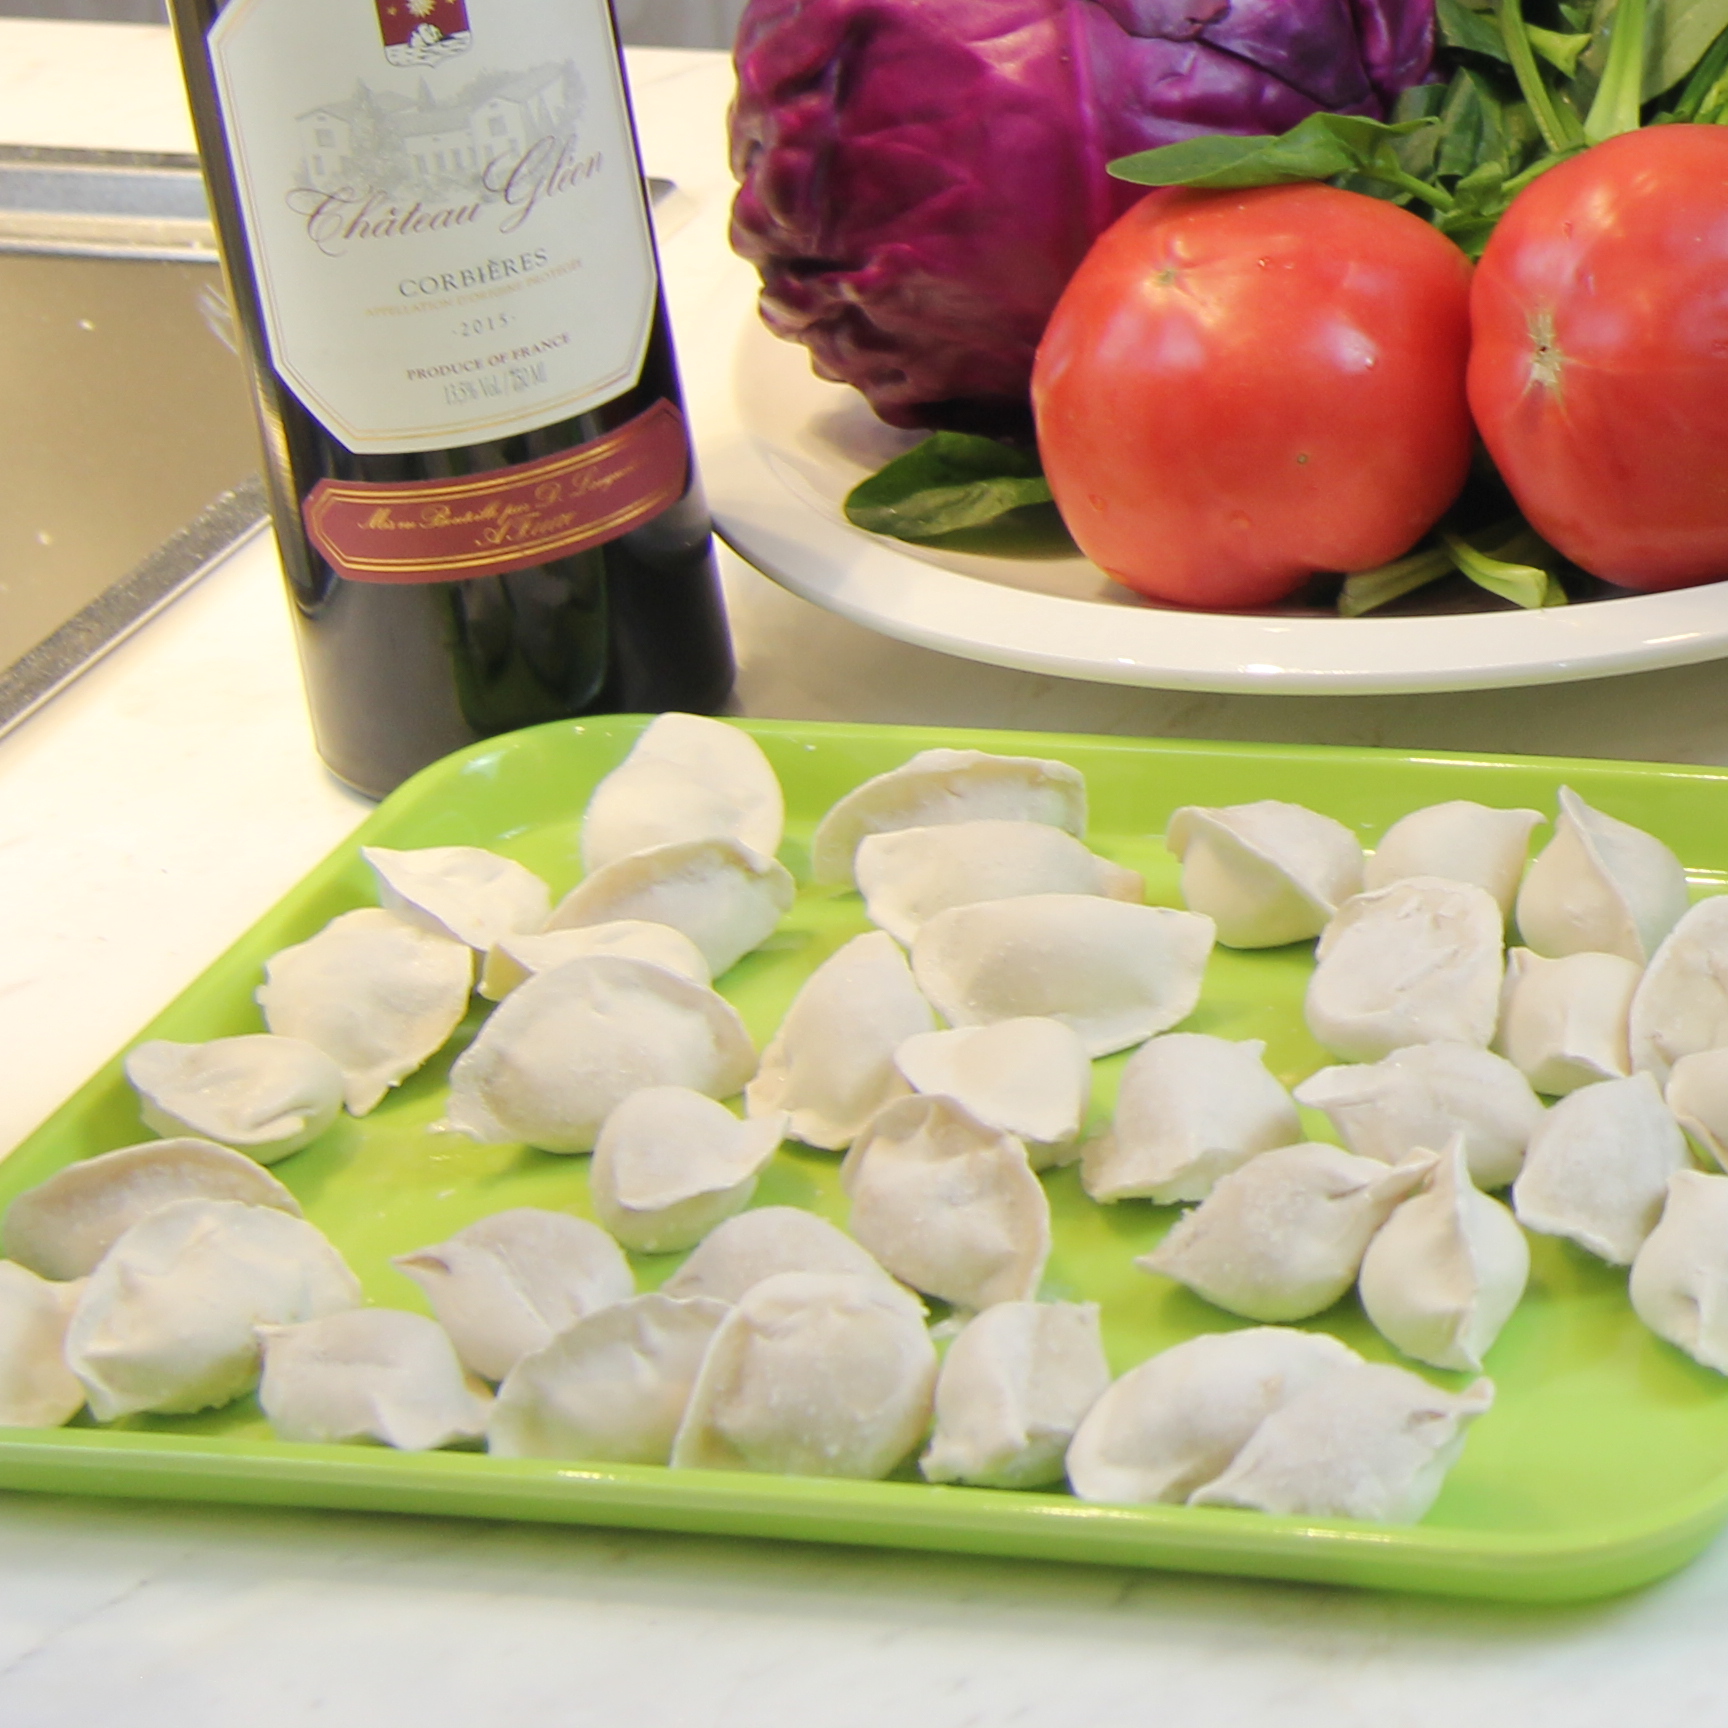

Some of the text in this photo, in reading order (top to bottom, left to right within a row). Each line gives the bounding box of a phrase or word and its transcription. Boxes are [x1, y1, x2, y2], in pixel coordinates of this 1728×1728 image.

[398, 248, 549, 298] CORBIÈRES
[406, 332, 571, 381] PRODUCE OF FRANCE
